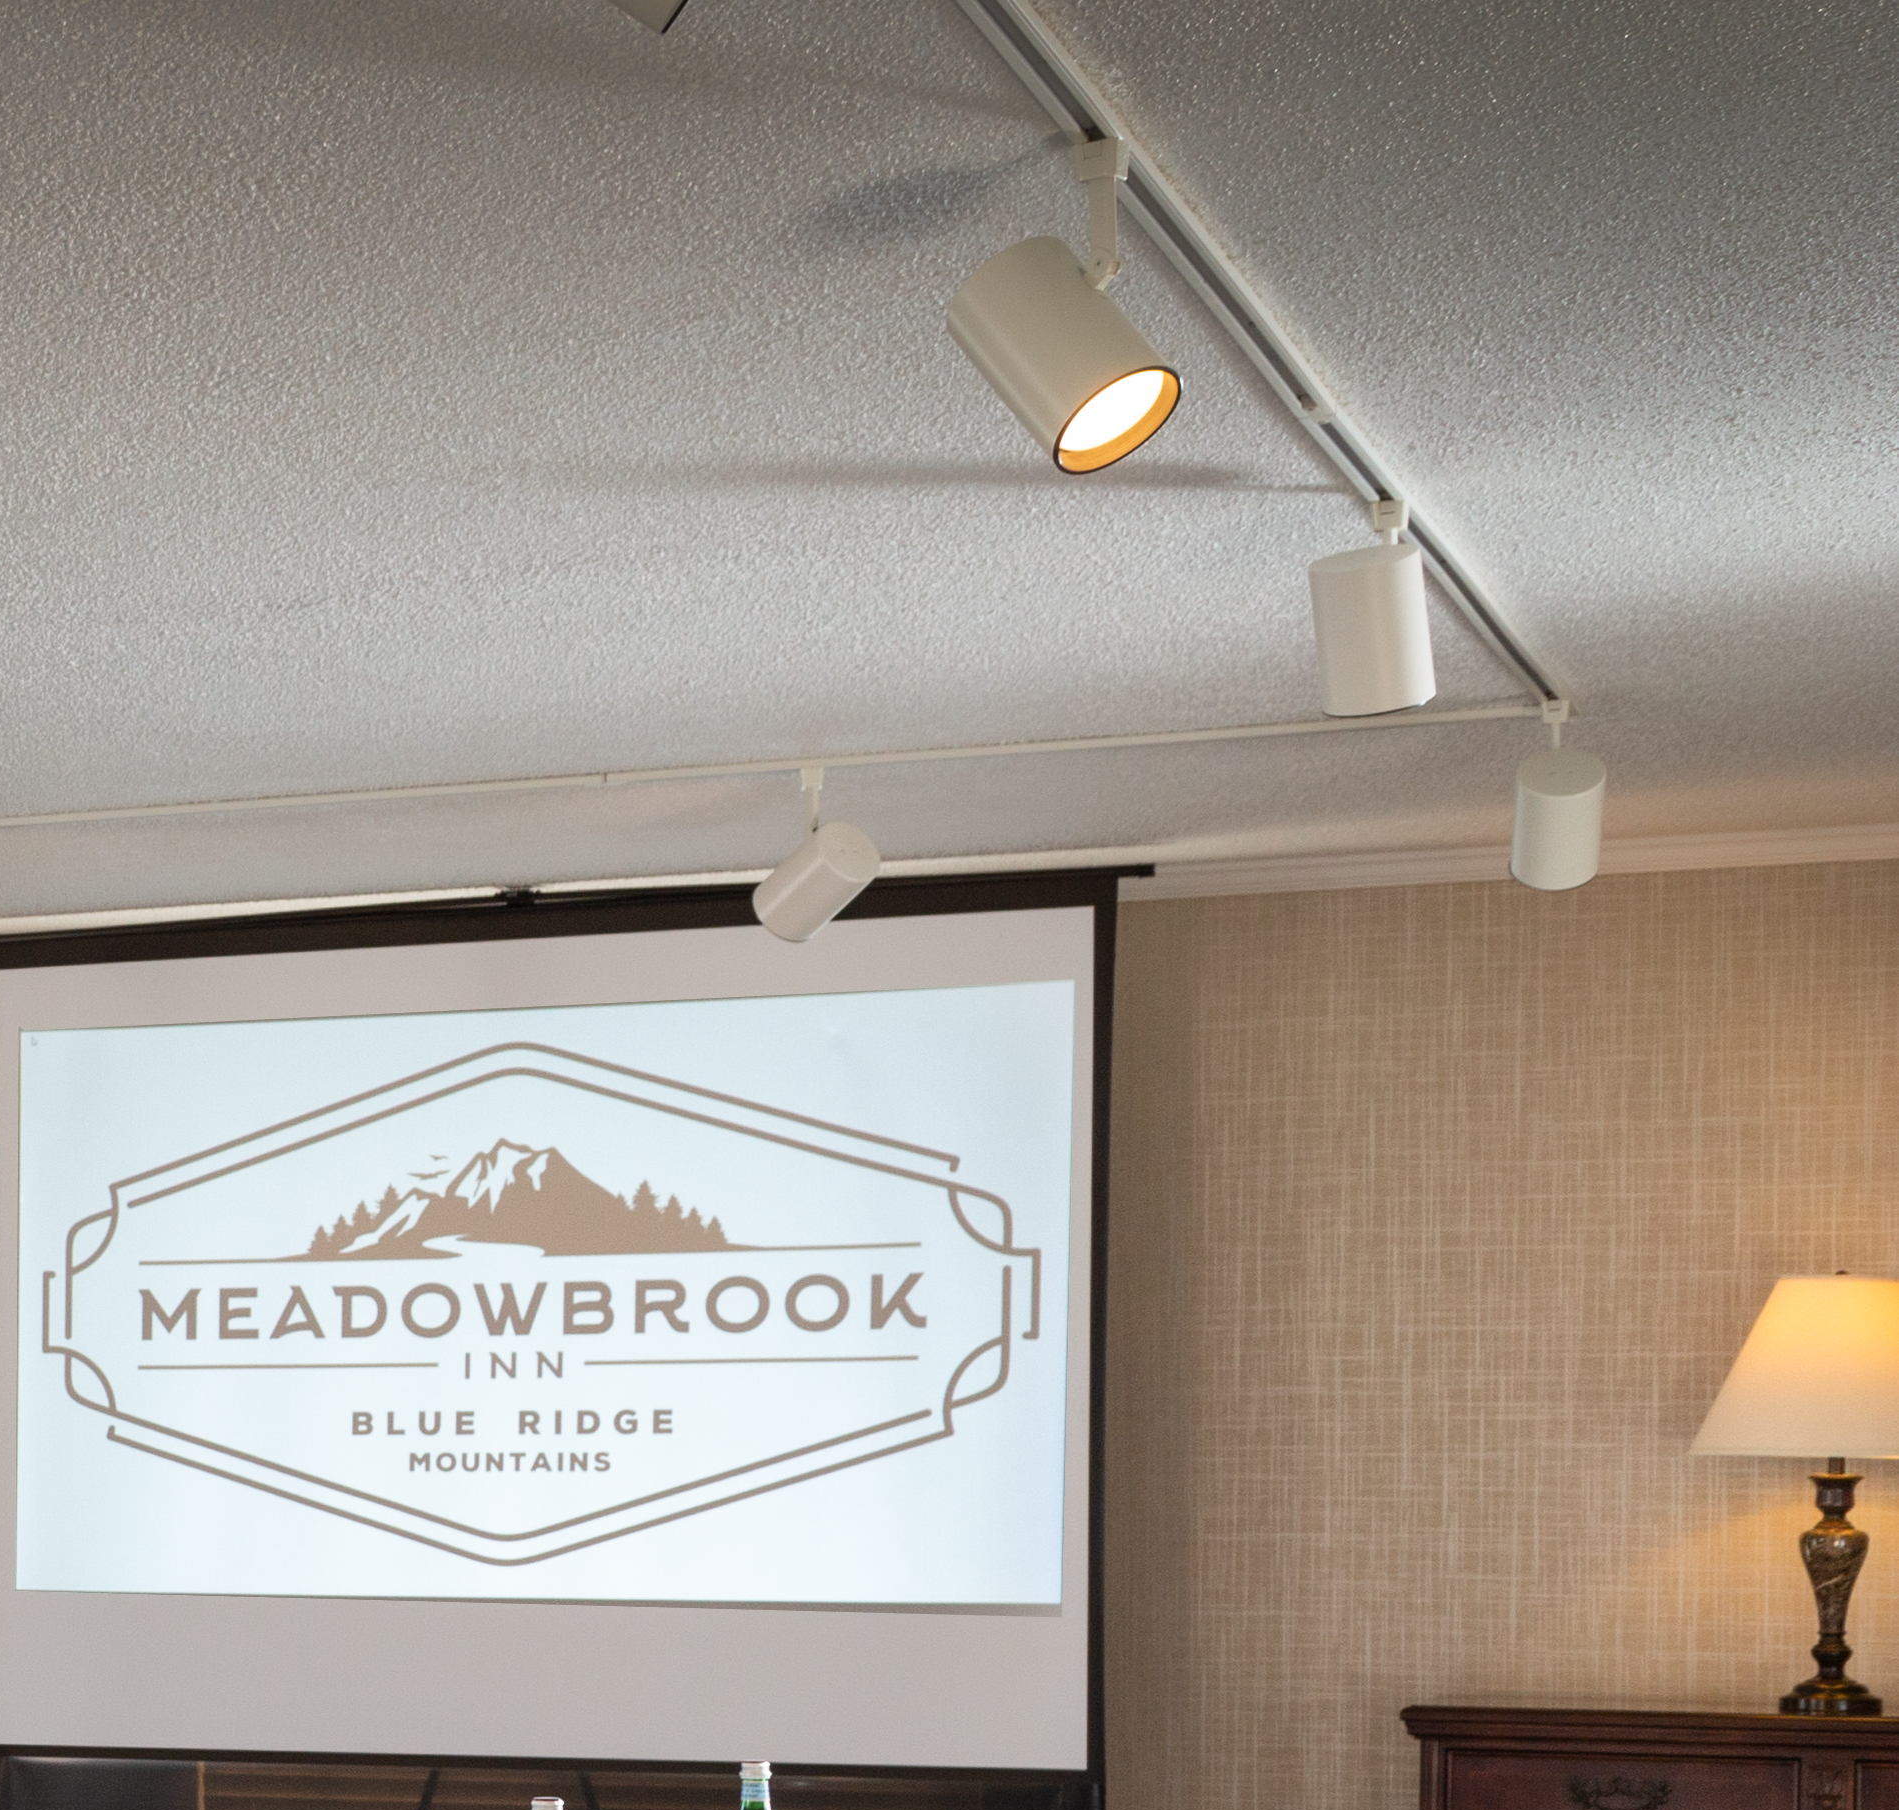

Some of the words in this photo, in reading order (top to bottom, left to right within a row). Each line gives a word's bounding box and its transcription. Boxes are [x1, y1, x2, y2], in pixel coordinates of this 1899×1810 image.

[139, 1272, 928, 1341] MEADOWBROOK
[464, 1352, 564, 1380] INN
[352, 1411, 475, 1436] BLUE
[518, 1409, 673, 1436] RIDGE
[409, 1452, 611, 1472] MOUNTAINS
